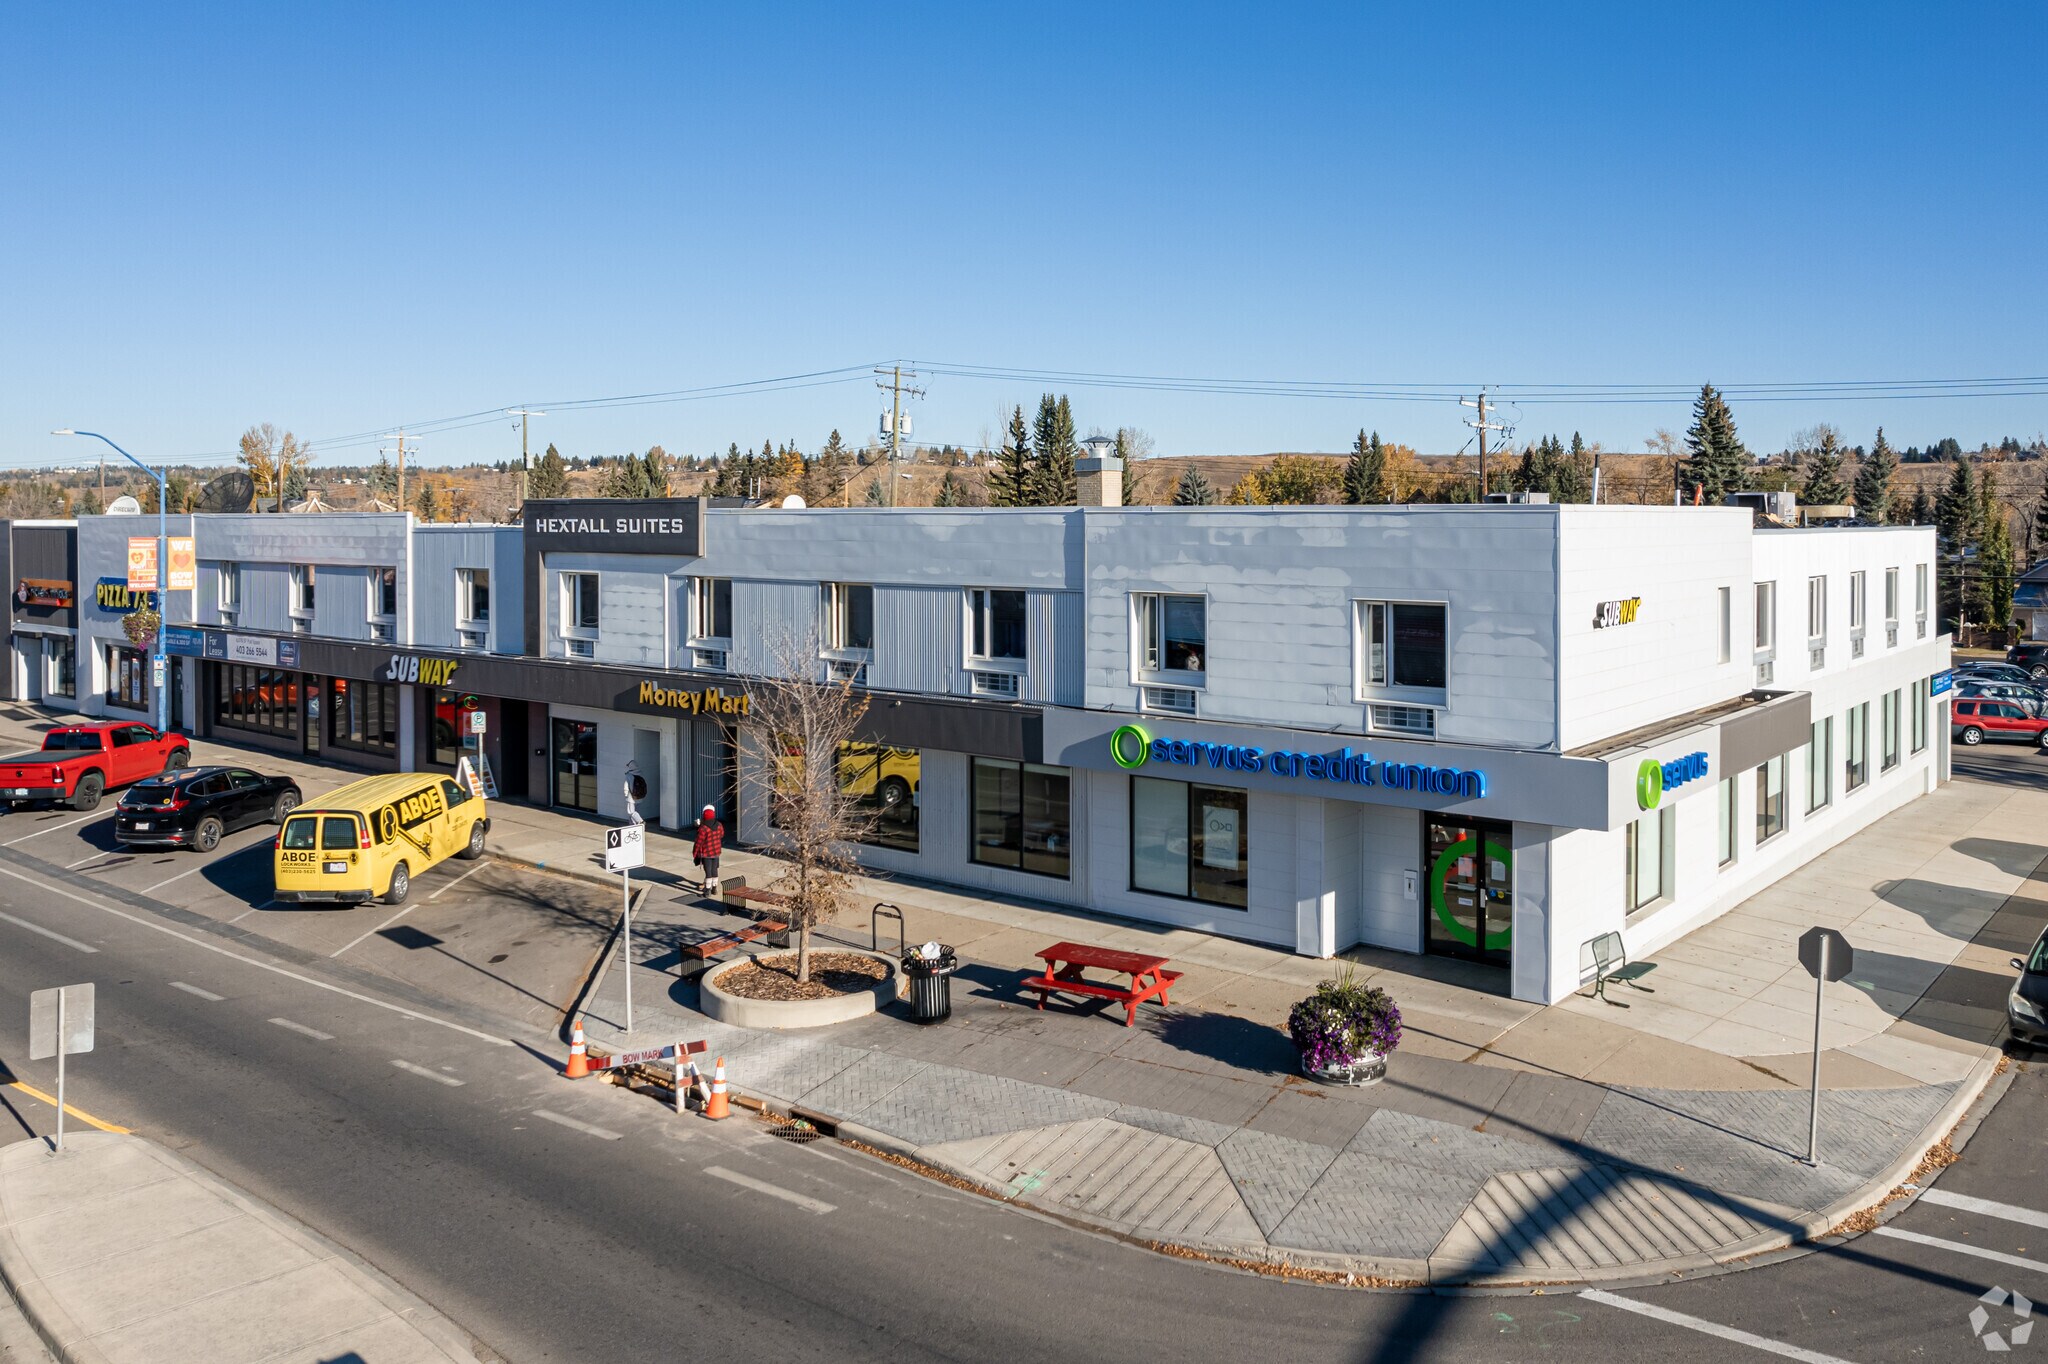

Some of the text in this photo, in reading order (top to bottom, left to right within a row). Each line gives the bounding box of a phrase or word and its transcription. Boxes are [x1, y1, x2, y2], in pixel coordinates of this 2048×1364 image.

[536, 518, 683, 534] HEXTALL SUITES
[170, 540, 193, 551] WE
[170, 571, 193, 580] BOW
[171, 579, 193, 587] NESS
[97, 584, 129, 608] PIZZA
[1594, 597, 1641, 629] SUBWAY
[209, 635, 218, 645] For
[209, 647, 223, 656] Lease
[236, 646, 245, 655] 403
[386, 655, 458, 686] SUBWAY
[640, 680, 750, 716] Money Mart
[1151, 738, 1487, 798] servus credit union
[1661, 751, 1709, 791] servus
[399, 788, 442, 824] ABOE
[281, 852, 316, 862] ABOE
[622, 1048, 664, 1064] BOW MARK
